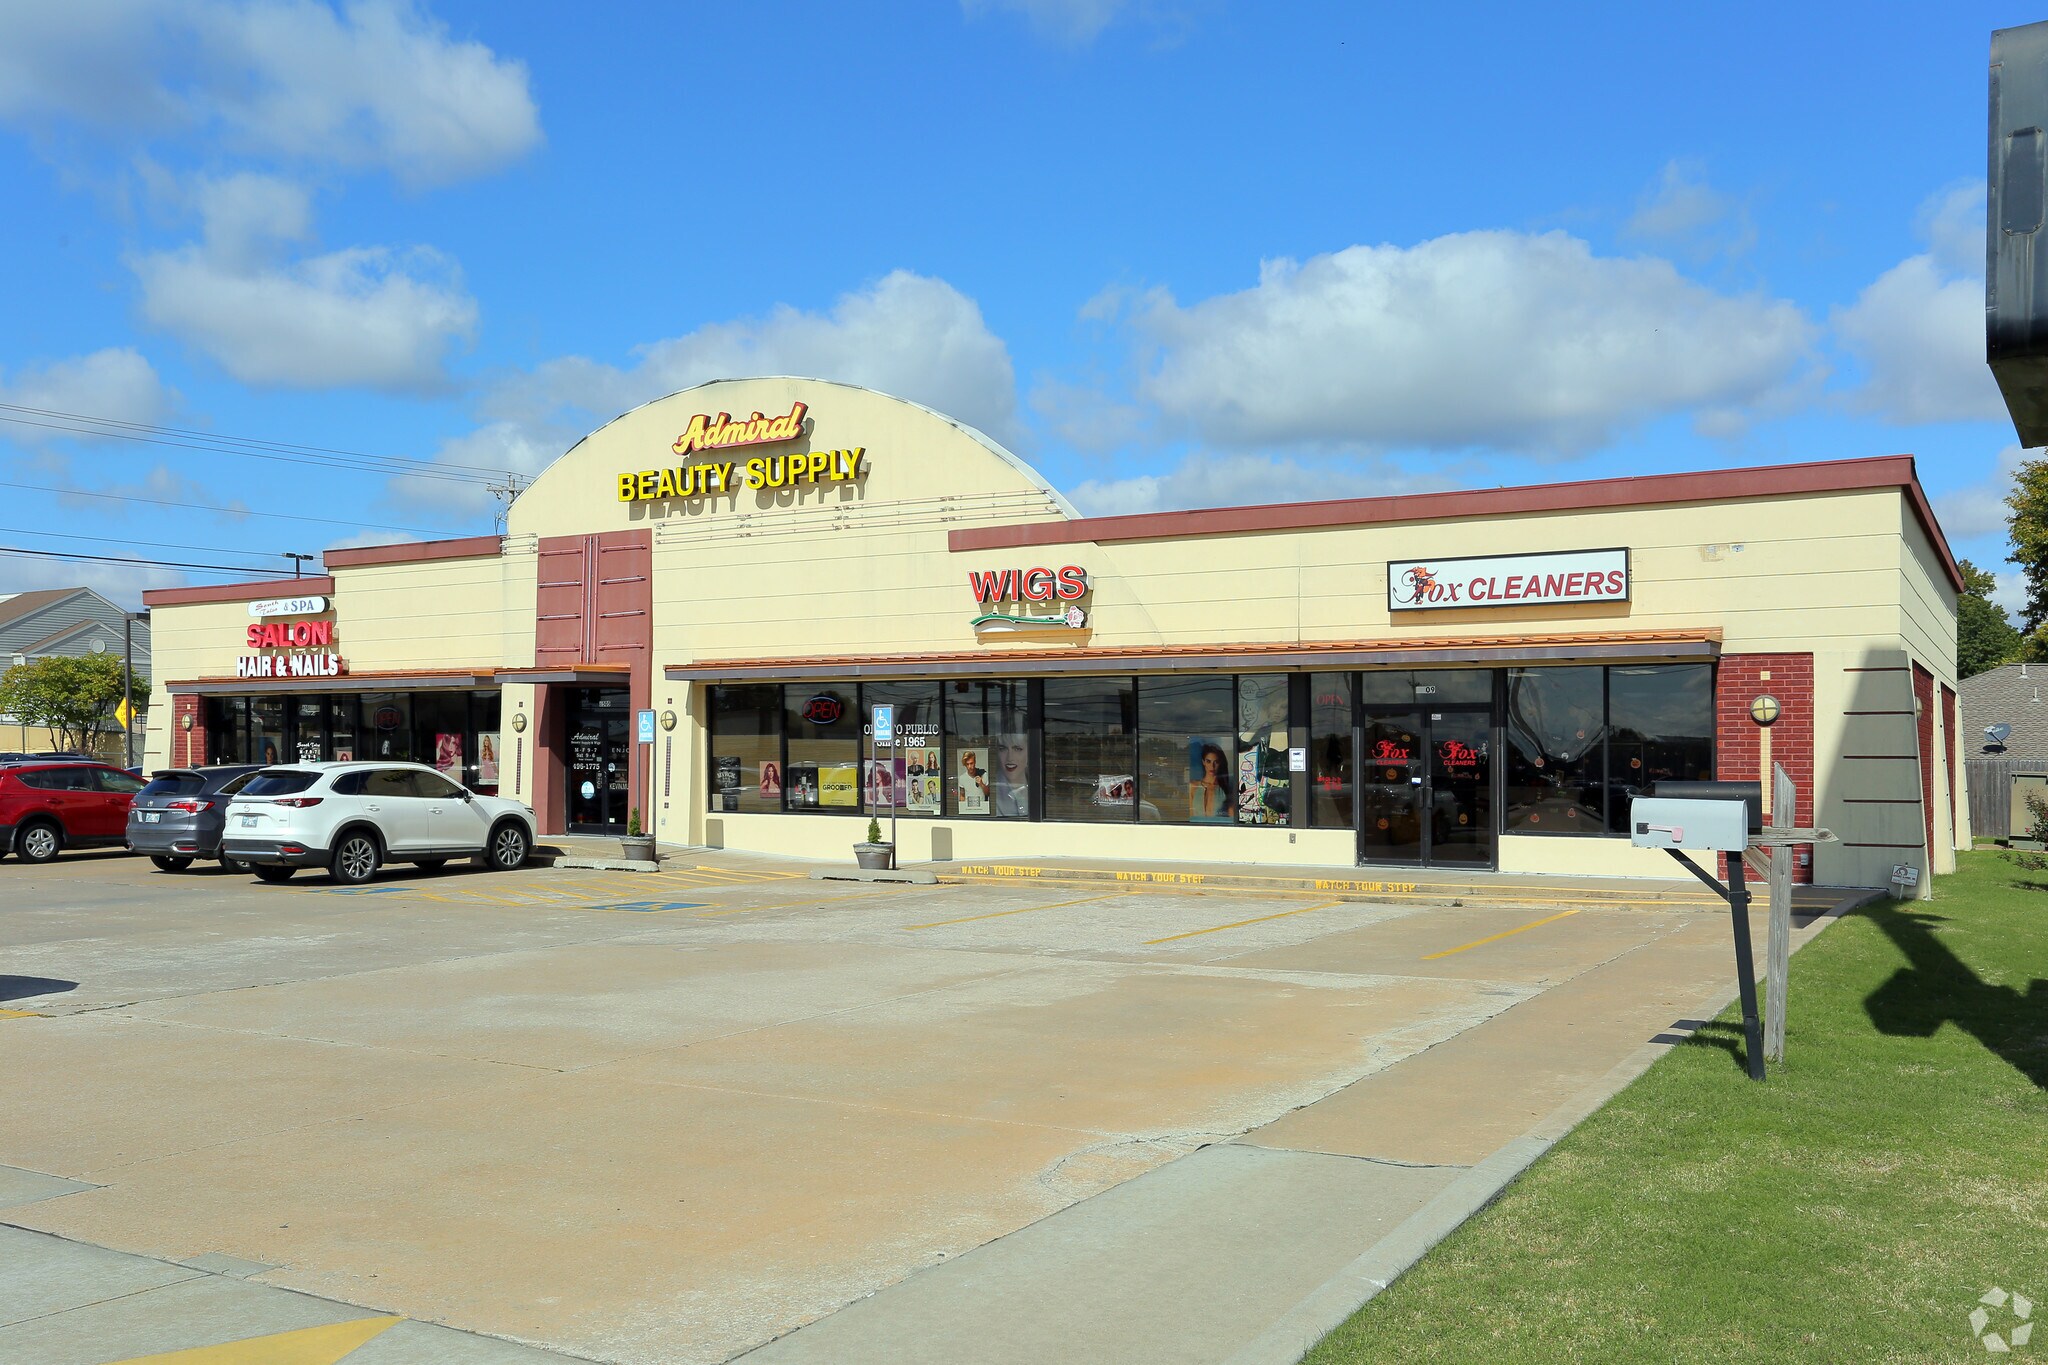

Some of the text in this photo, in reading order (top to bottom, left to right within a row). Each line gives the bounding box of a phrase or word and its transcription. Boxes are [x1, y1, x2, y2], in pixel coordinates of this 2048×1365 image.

[672, 401, 809, 455] Admiral
[618, 447, 866, 502] BEAUTY SUPPLY
[967, 564, 1086, 603] WIGS
[1468, 570, 1625, 601] CLEANERS
[290, 599, 315, 612] SPA
[247, 620, 333, 648] SALON
[236, 653, 339, 678] HAIR & NAILS
[1315, 694, 1344, 705] OPEN
[802, 701, 841, 719] OPEN
[571, 732, 600, 741] Admiral
[905, 723, 939, 735] PUBLIC
[903, 736, 926, 747] 1965
[1372, 740, 1410, 759] Fox
[1439, 740, 1479, 760] Fox
[961, 865, 1041, 878] WATCH YOUR STEP
[1116, 872, 1204, 884] WATCH YOUR STEP
[1315, 880, 1416, 892] WATCH YOUR STEP
